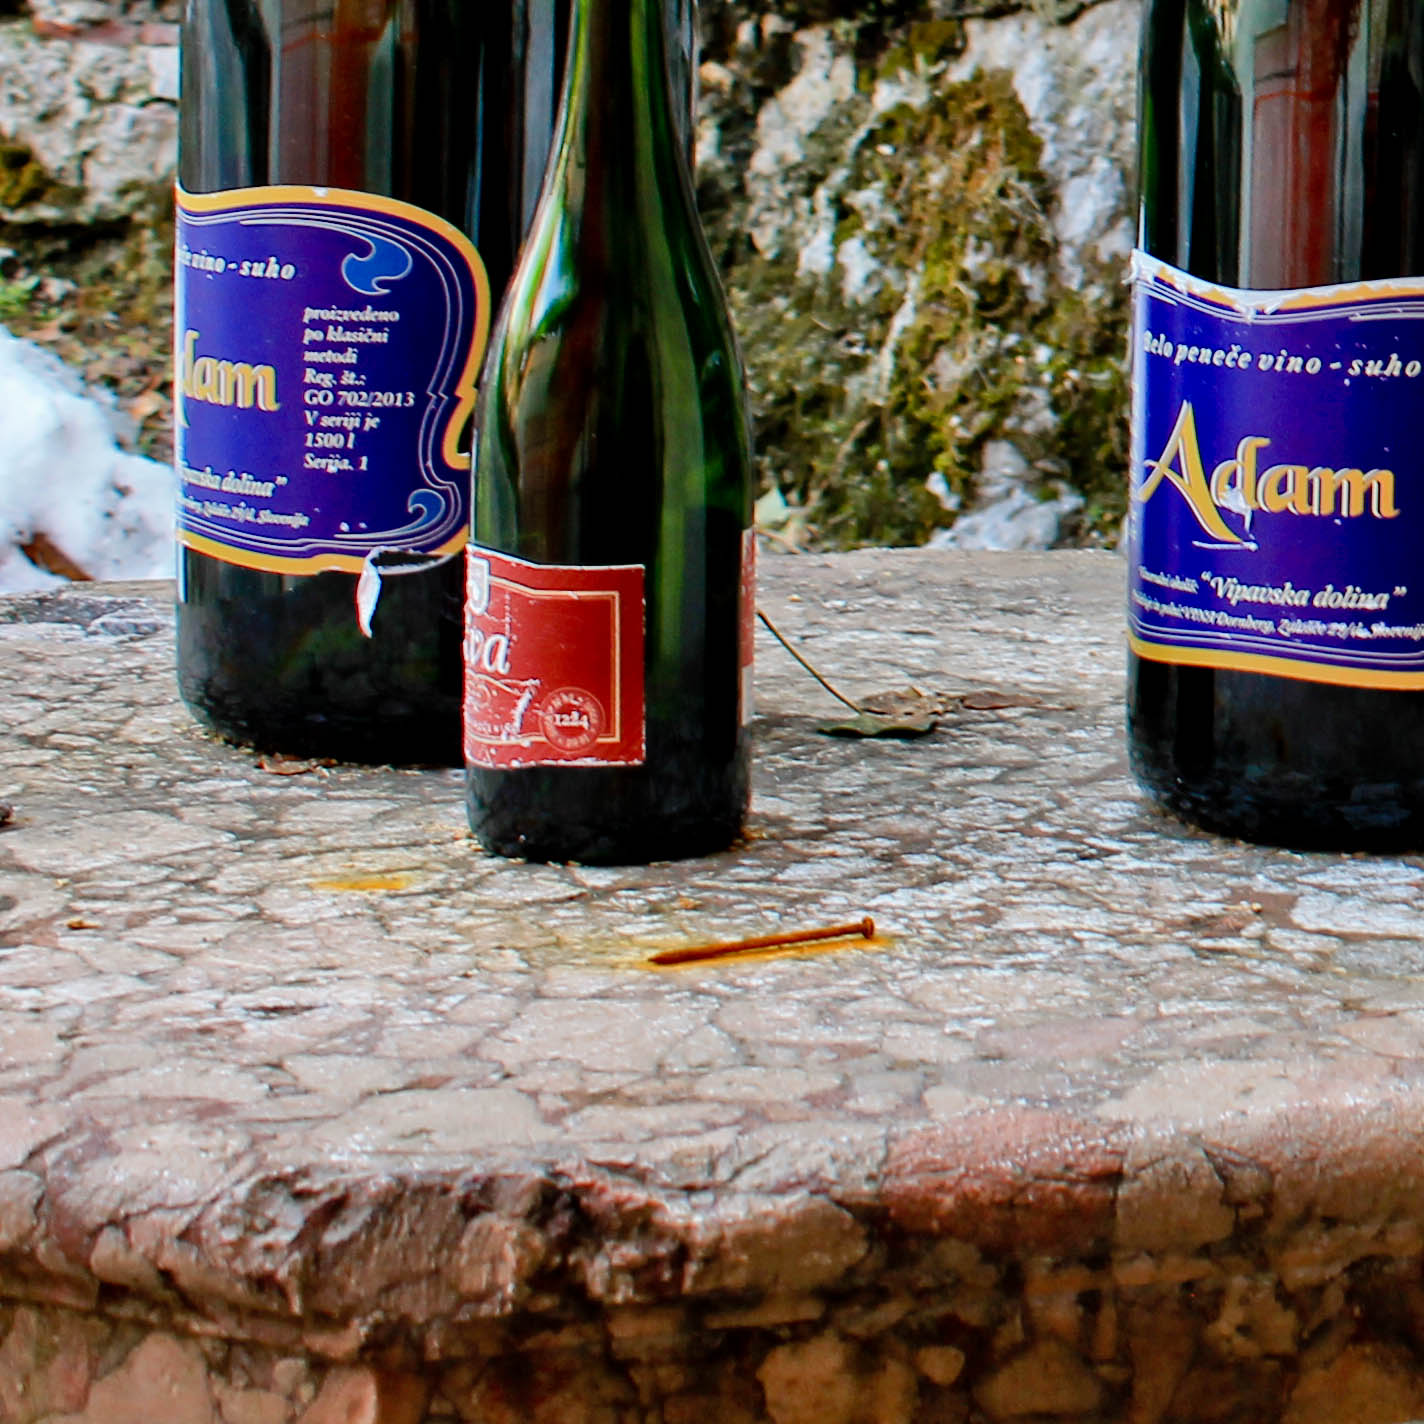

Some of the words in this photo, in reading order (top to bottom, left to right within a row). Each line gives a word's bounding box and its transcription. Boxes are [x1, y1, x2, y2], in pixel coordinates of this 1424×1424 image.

[239, 256, 296, 280] suho
[302, 305, 400, 324] proizvedeno
[302, 328, 325, 346] po
[326, 325, 390, 344] klasični
[303, 347, 359, 364] metodi
[1174, 344, 1252, 369] peneče
[1258, 349, 1322, 374] vino
[1348, 352, 1422, 378] suho
[304, 368, 338, 388] Reg.
[304, 389, 334, 406] GO
[337, 390, 416, 408] 702/2013
[304, 410, 319, 426] V
[320, 412, 362, 431] seriji
[363, 412, 381, 432] je
[304, 432, 345, 448] 1500
[358, 456, 368, 472] 1
[1138, 399, 1400, 546] Adam
